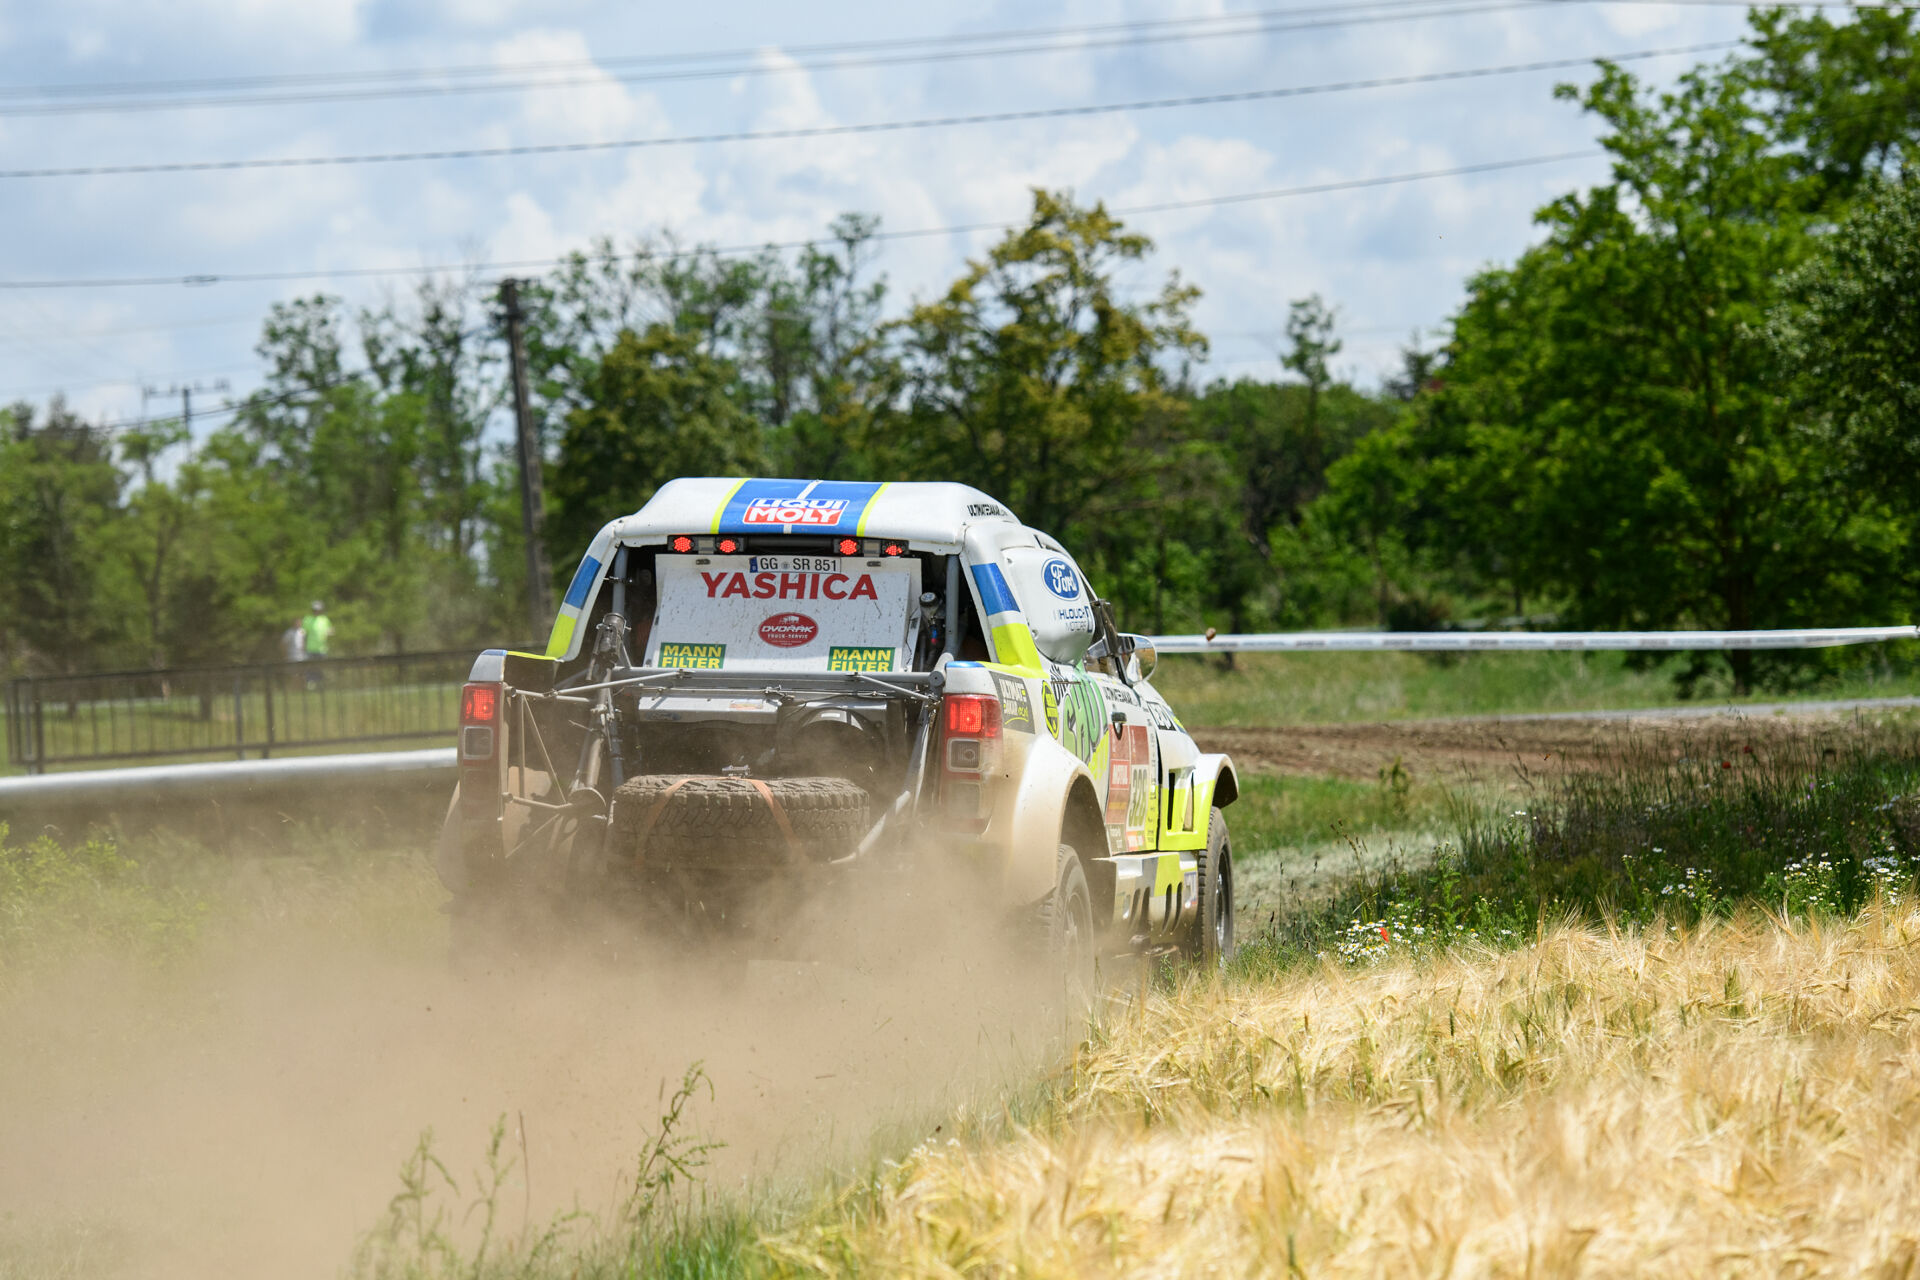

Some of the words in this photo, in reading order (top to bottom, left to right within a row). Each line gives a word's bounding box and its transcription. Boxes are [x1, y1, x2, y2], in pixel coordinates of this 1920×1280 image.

[754, 499, 845, 509] LIQUI
[748, 508, 842, 523] MOLY
[760, 557, 778, 570] GG
[792, 558, 811, 571] SR
[814, 558, 837, 572] 851
[1050, 563, 1078, 594] Ford
[701, 572, 879, 601] YASHICA
[663, 645, 722, 657] MANN
[832, 649, 891, 661] MANN
[661, 656, 721, 669] FILTER
[830, 660, 890, 672] FILTER
